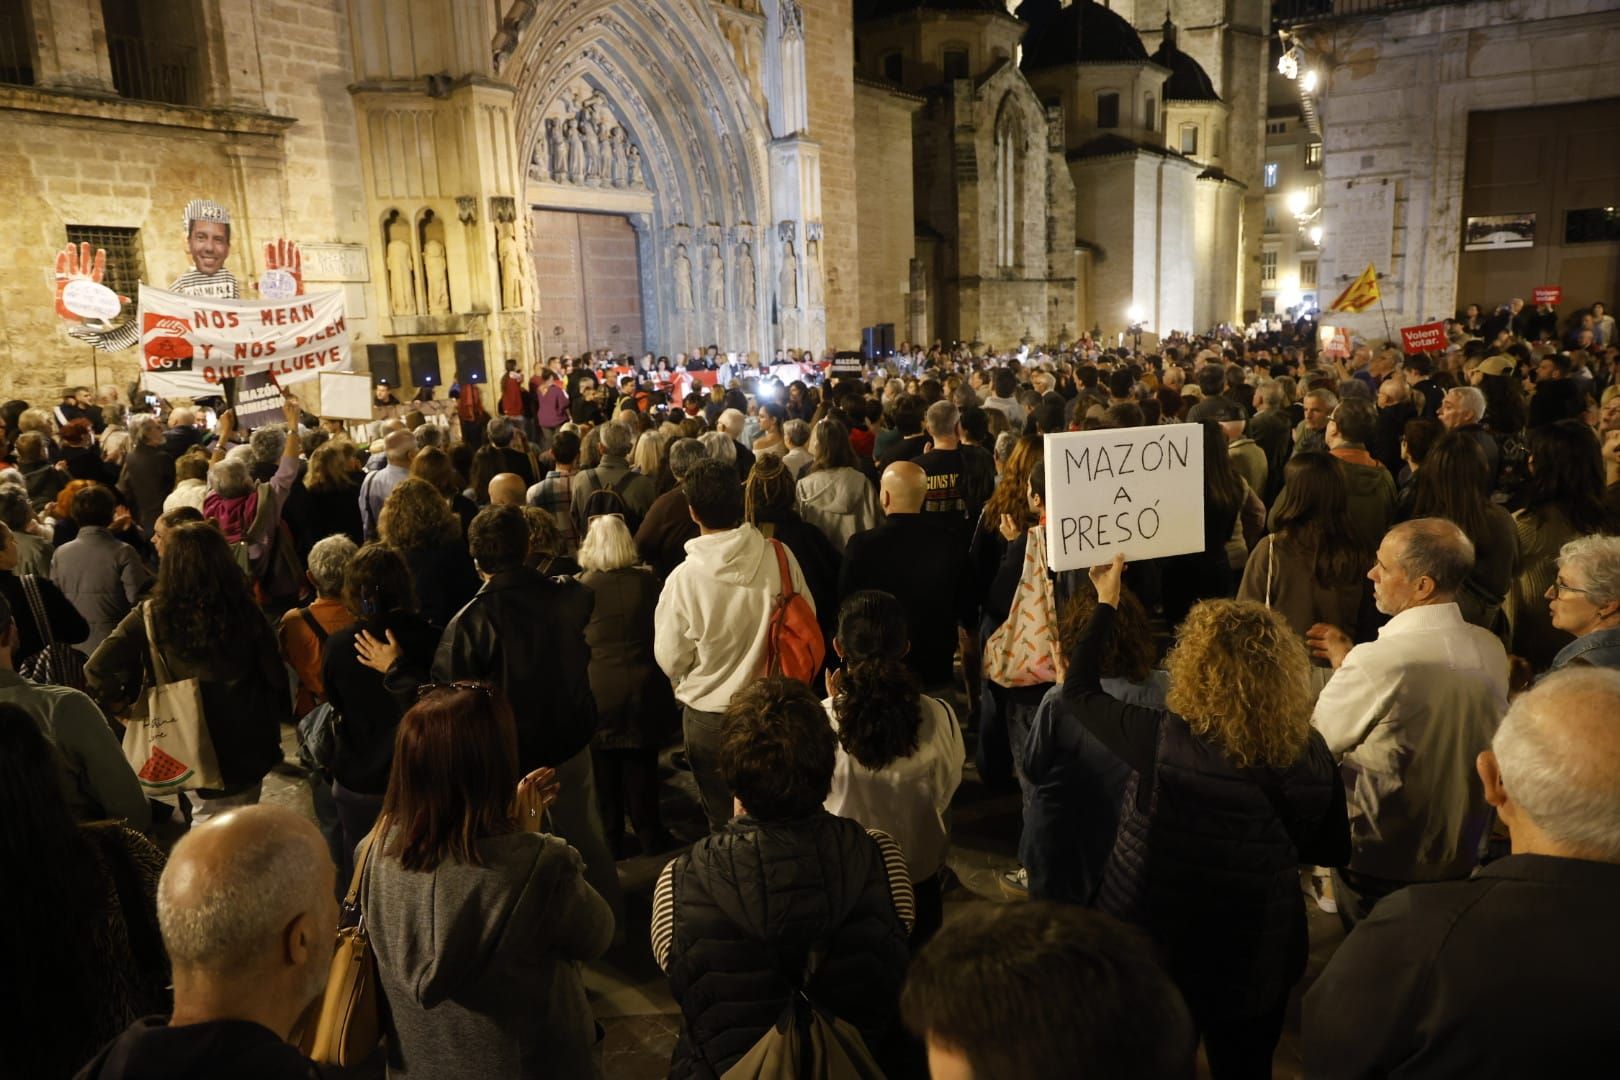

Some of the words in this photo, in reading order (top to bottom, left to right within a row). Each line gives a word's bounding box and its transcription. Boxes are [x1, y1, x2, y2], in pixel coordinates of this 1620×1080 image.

[194, 310, 239, 329] NOS
[261, 304, 314, 326] MEAN
[1405, 328, 1440, 341] Volem
[1409, 337, 1440, 348] votar.
[200, 344, 214, 359] Y
[234, 341, 276, 360] NOS
[148, 356, 185, 369] CGT
[203, 364, 245, 383] QUE
[269, 346, 341, 376] LLUEVE
[1065, 433, 1188, 484] MAZÓN
[1113, 486, 1132, 504] A
[1061, 499, 1160, 555] PRESÓ
